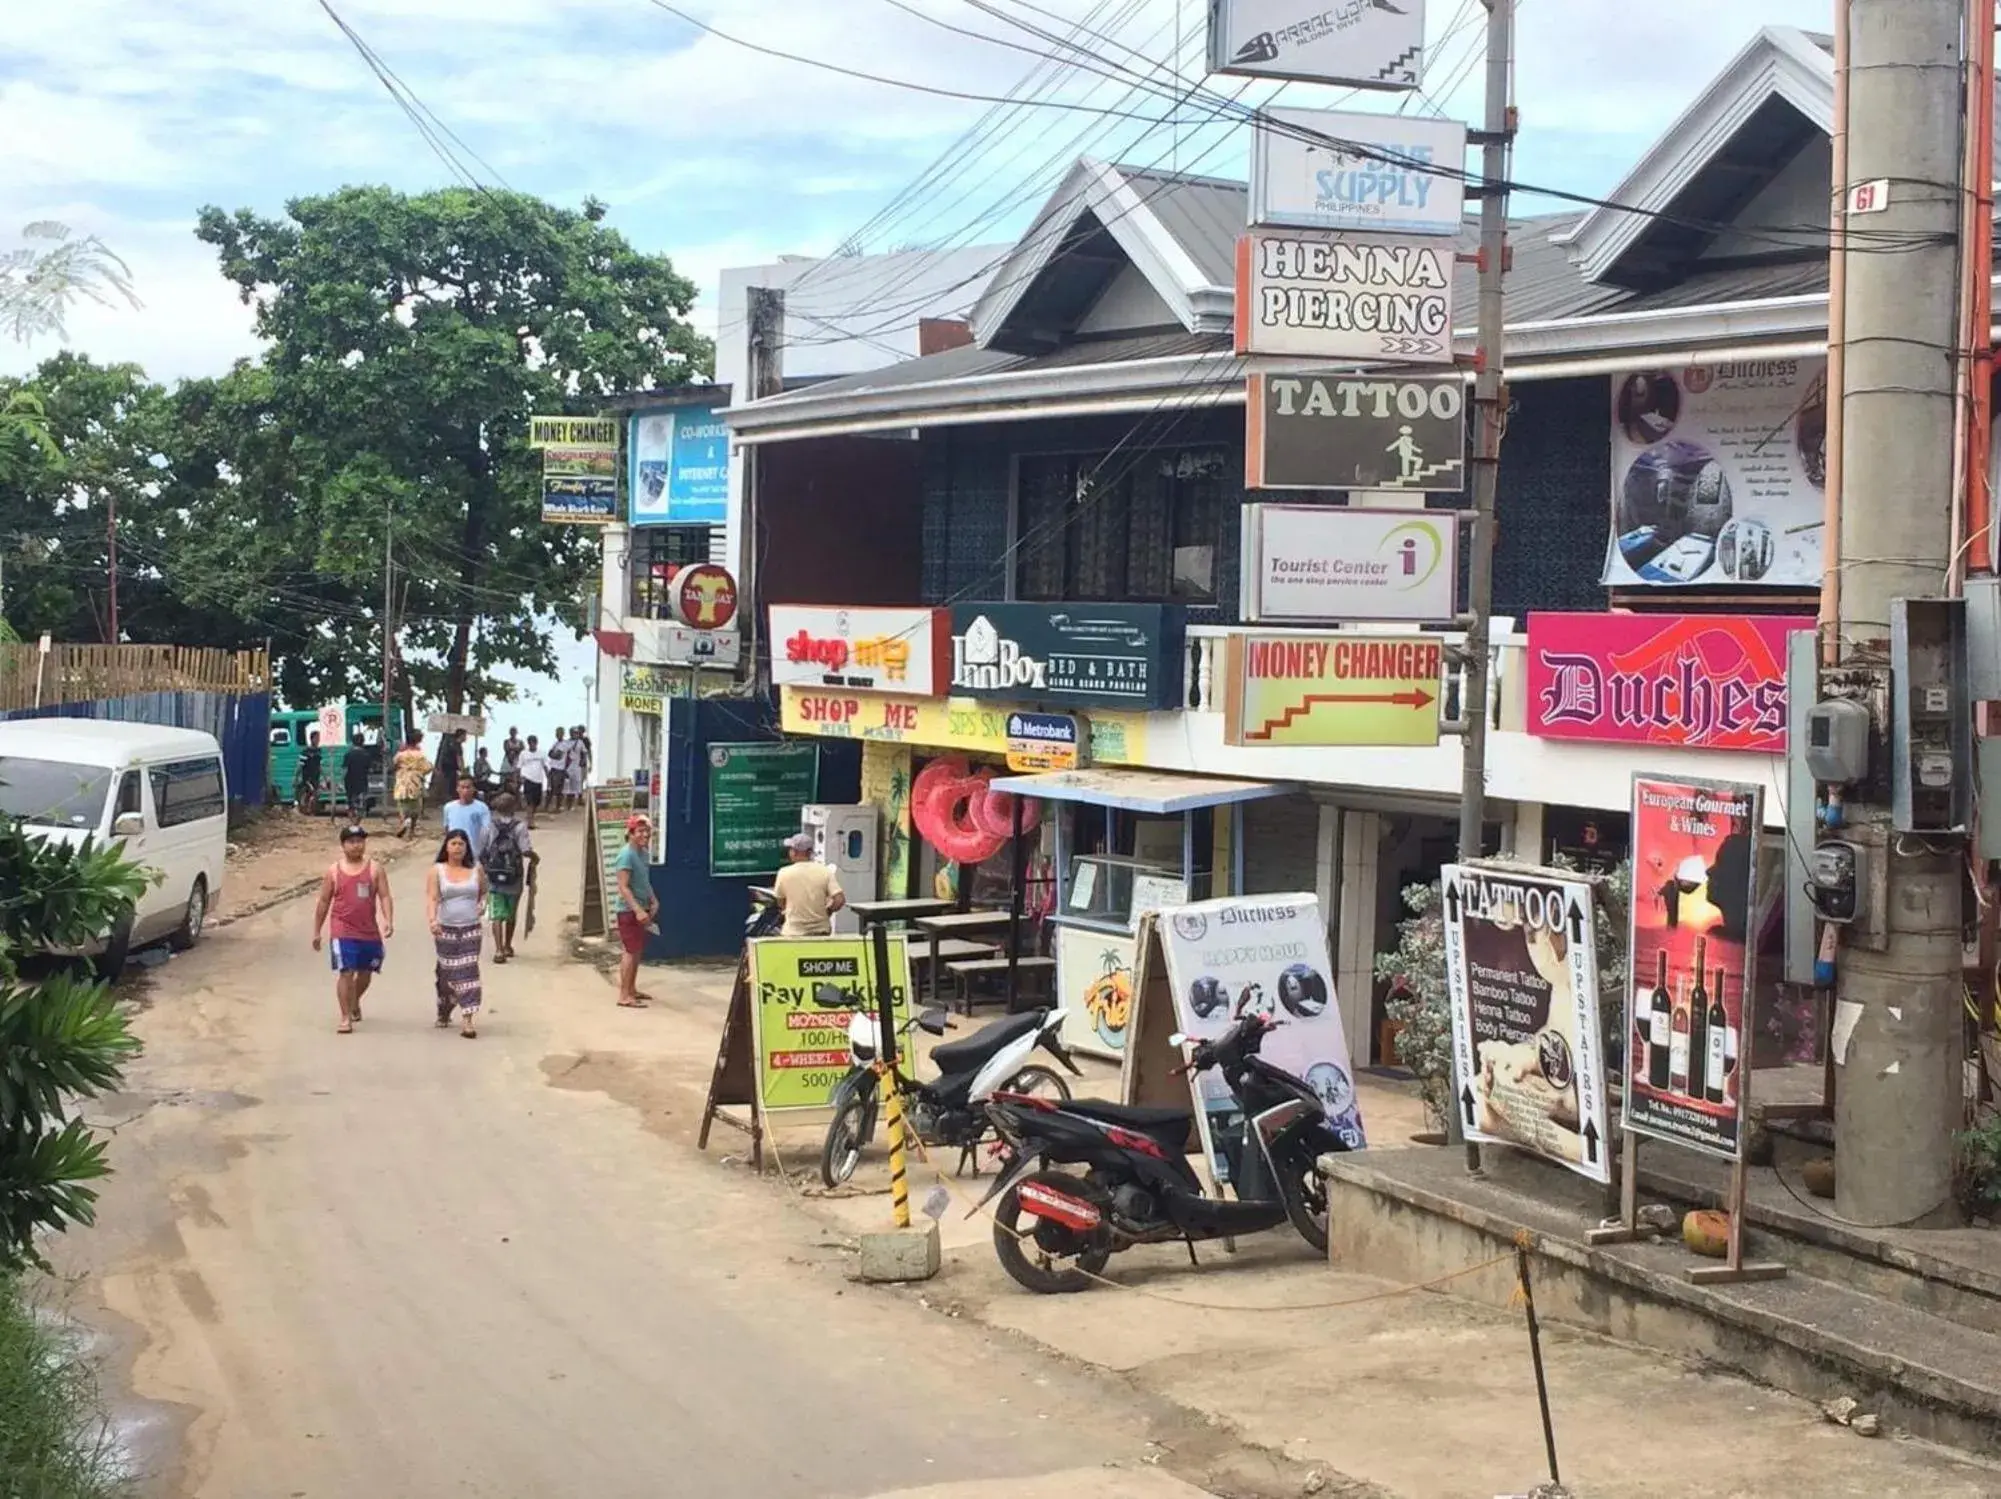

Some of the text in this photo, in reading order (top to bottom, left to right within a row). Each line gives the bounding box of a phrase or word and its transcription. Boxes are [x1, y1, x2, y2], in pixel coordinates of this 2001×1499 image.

[1316, 170, 1434, 209] SUPPLY
[1315, 201, 1381, 215] PHILIPPINES
[1261, 239, 1447, 288] HENNA
[1261, 286, 1447, 336] PIERCING
[1271, 379, 1461, 419] TATTOO
[534, 422, 615, 442] MONEY CHANGER
[1271, 558, 1389, 575] Tourist Center
[786, 629, 848, 672] shop
[1249, 641, 1440, 680] MONEY CHANGER
[1048, 658, 1147, 679] BED & BATH
[1541, 650, 1788, 744] Duches
[800, 698, 919, 730] SHOP ME
[1023, 721, 1072, 740] Metrobank
[1642, 789, 1748, 817] European Gourmet
[1670, 815, 1717, 837] & Wines
[1221, 904, 1297, 926] Duchess
[1462, 874, 1565, 933] TATTOO
[803, 960, 853, 974] SHOP ME
[1471, 961, 1547, 990] Permanent Tattoo
[762, 982, 805, 1010] Pay
[1472, 980, 1537, 1008] Bamboo Tattoo
[788, 1013, 853, 1028] MOTORC
[1474, 1000, 1532, 1024] Henna Tattoo
[1475, 1018, 1498, 1040] Body
[773, 1053, 832, 1067] 4-WHEEL
